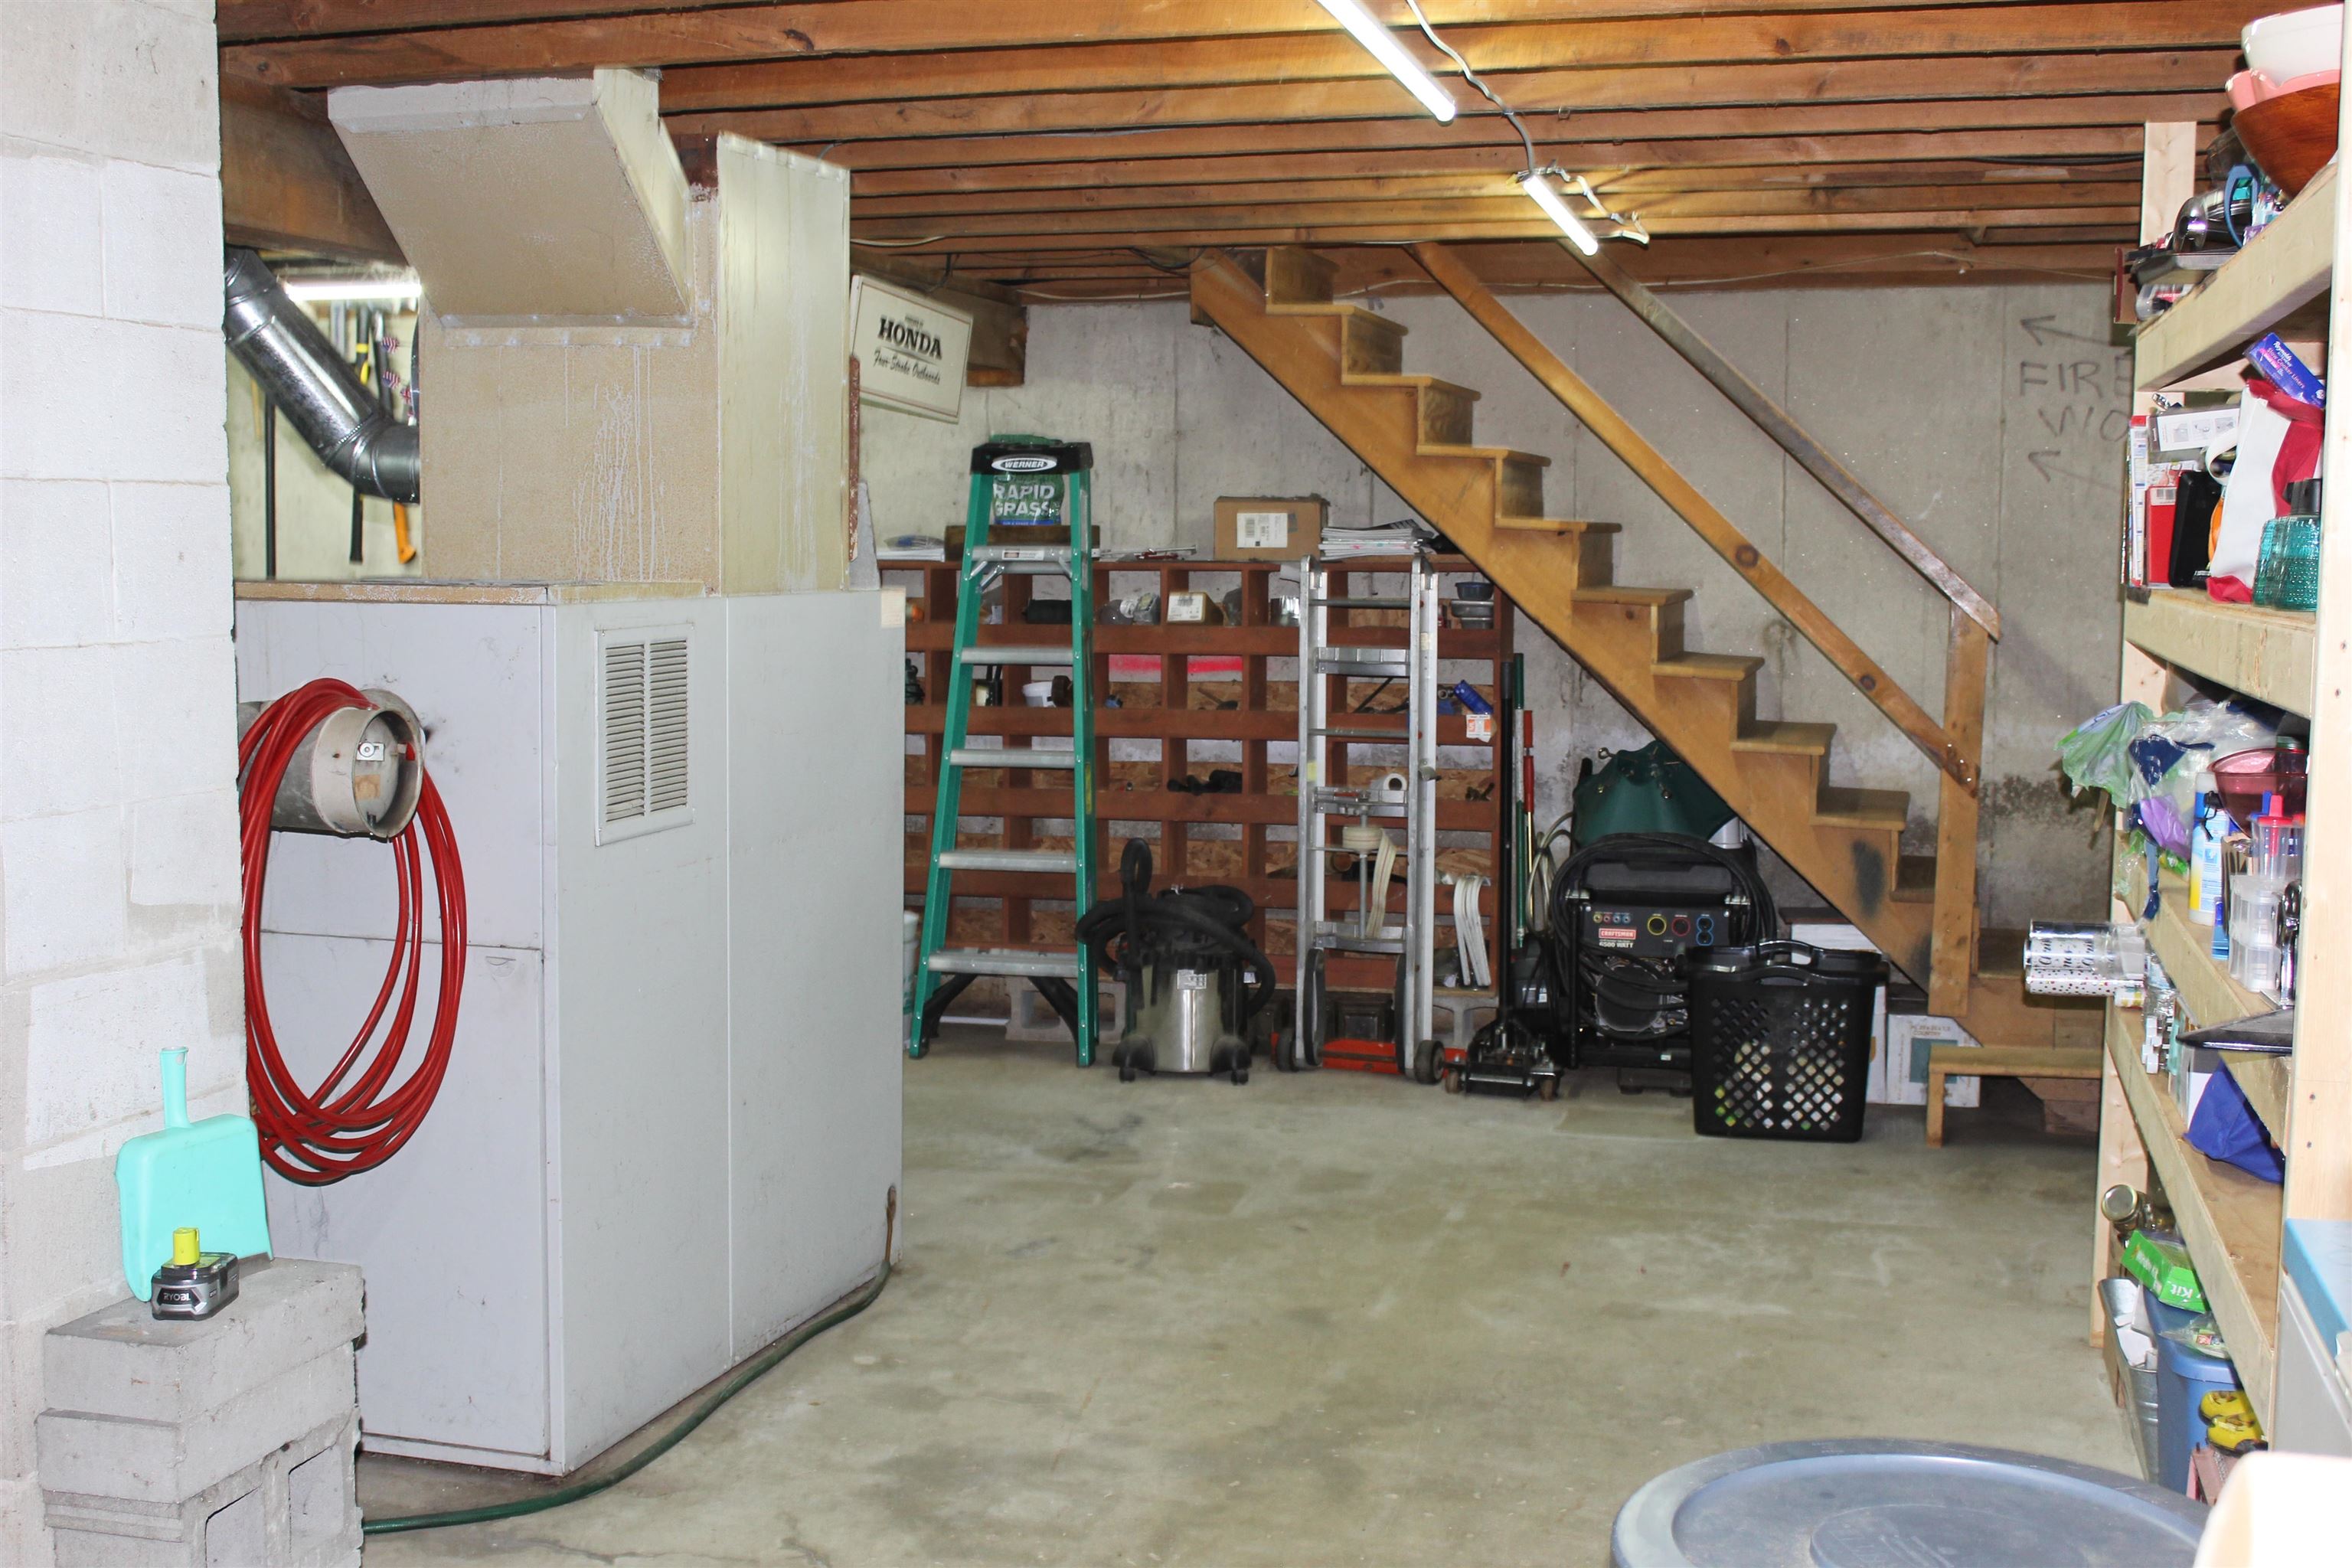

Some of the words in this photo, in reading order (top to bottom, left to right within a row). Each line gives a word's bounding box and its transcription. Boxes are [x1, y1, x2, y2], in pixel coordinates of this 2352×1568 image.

[877, 316, 942, 360] HONDA
[2273, 341, 2292, 361] Reynolds
[2019, 355, 2132, 398] FIRE
[2267, 348, 2278, 359] Slow
[2277, 358, 2292, 375] Cooker
[2292, 374, 2305, 389] Liners
[992, 483, 1055, 500] RAPID
[995, 501, 1050, 517] GRASS
[2170, 1283, 2194, 1298] Kit
